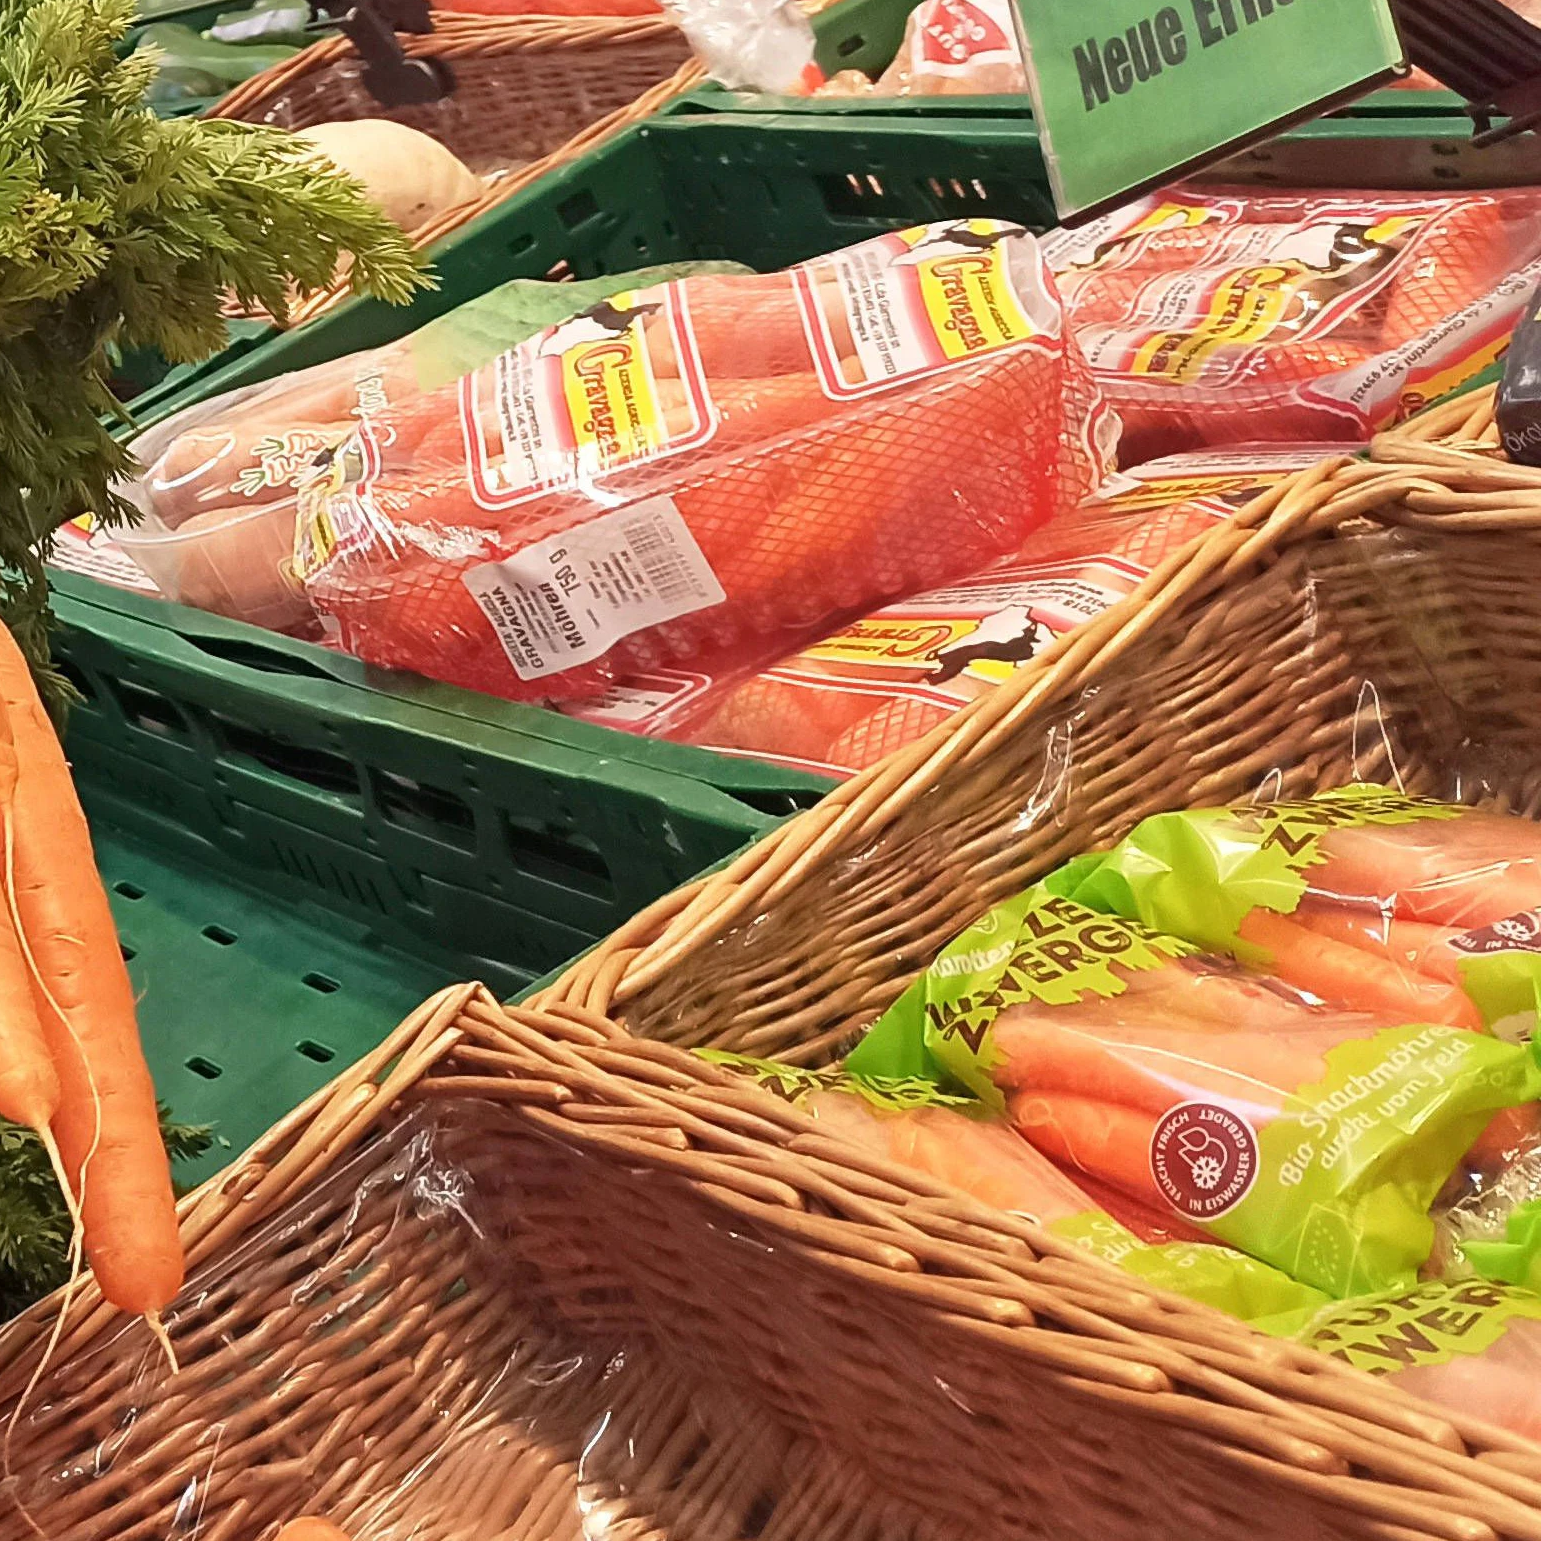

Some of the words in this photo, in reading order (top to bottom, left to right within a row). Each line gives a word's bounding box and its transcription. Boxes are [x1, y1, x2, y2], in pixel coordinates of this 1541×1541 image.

[1072, 7, 1188, 112] Neue
[931, 256, 992, 351] Gravagna
[554, 565, 582, 598] 750
[493, 586, 545, 669] GRAVAGNA
[538, 582, 587, 650] Möhren
[1157, 1111, 1189, 1150] FRISCH
[1199, 1109, 1247, 1148] GEBADET
[1320, 1111, 1380, 1170] direkt
[1377, 1079, 1430, 1118] vom
[1156, 1152, 1182, 1201] FEUCHT
[1205, 1151, 1250, 1210] EISWASSER
[1278, 1141, 1314, 1187] Bio
[1189, 1199, 1202, 1211] IN
